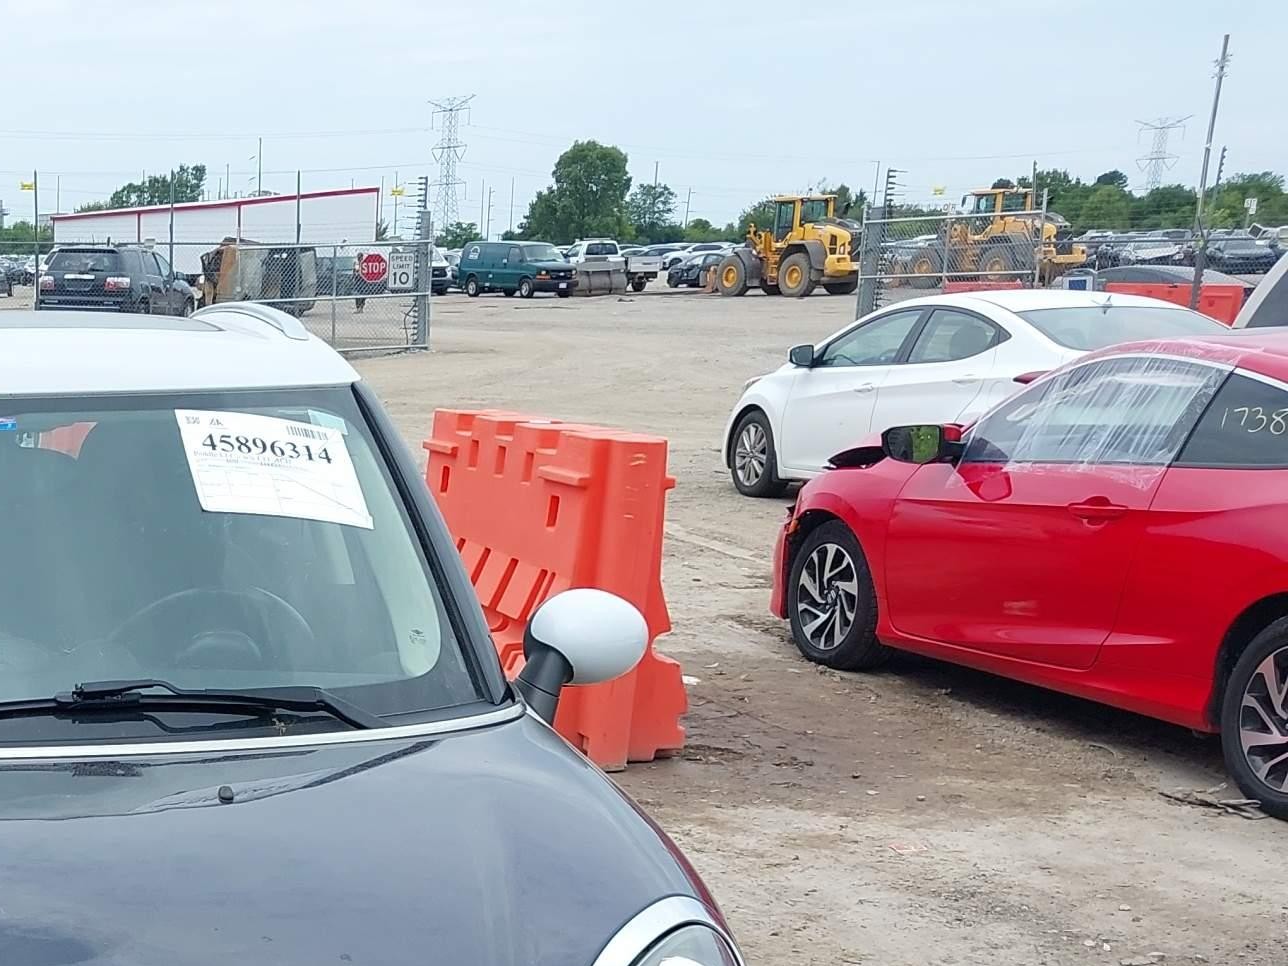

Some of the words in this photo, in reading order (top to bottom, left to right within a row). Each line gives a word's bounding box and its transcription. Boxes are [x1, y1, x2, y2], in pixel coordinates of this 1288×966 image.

[362, 262, 385, 274] STOP
[392, 271, 410, 285] 10
[1221, 406, 1288, 435] 1738
[202, 433, 332, 464] 45896314
